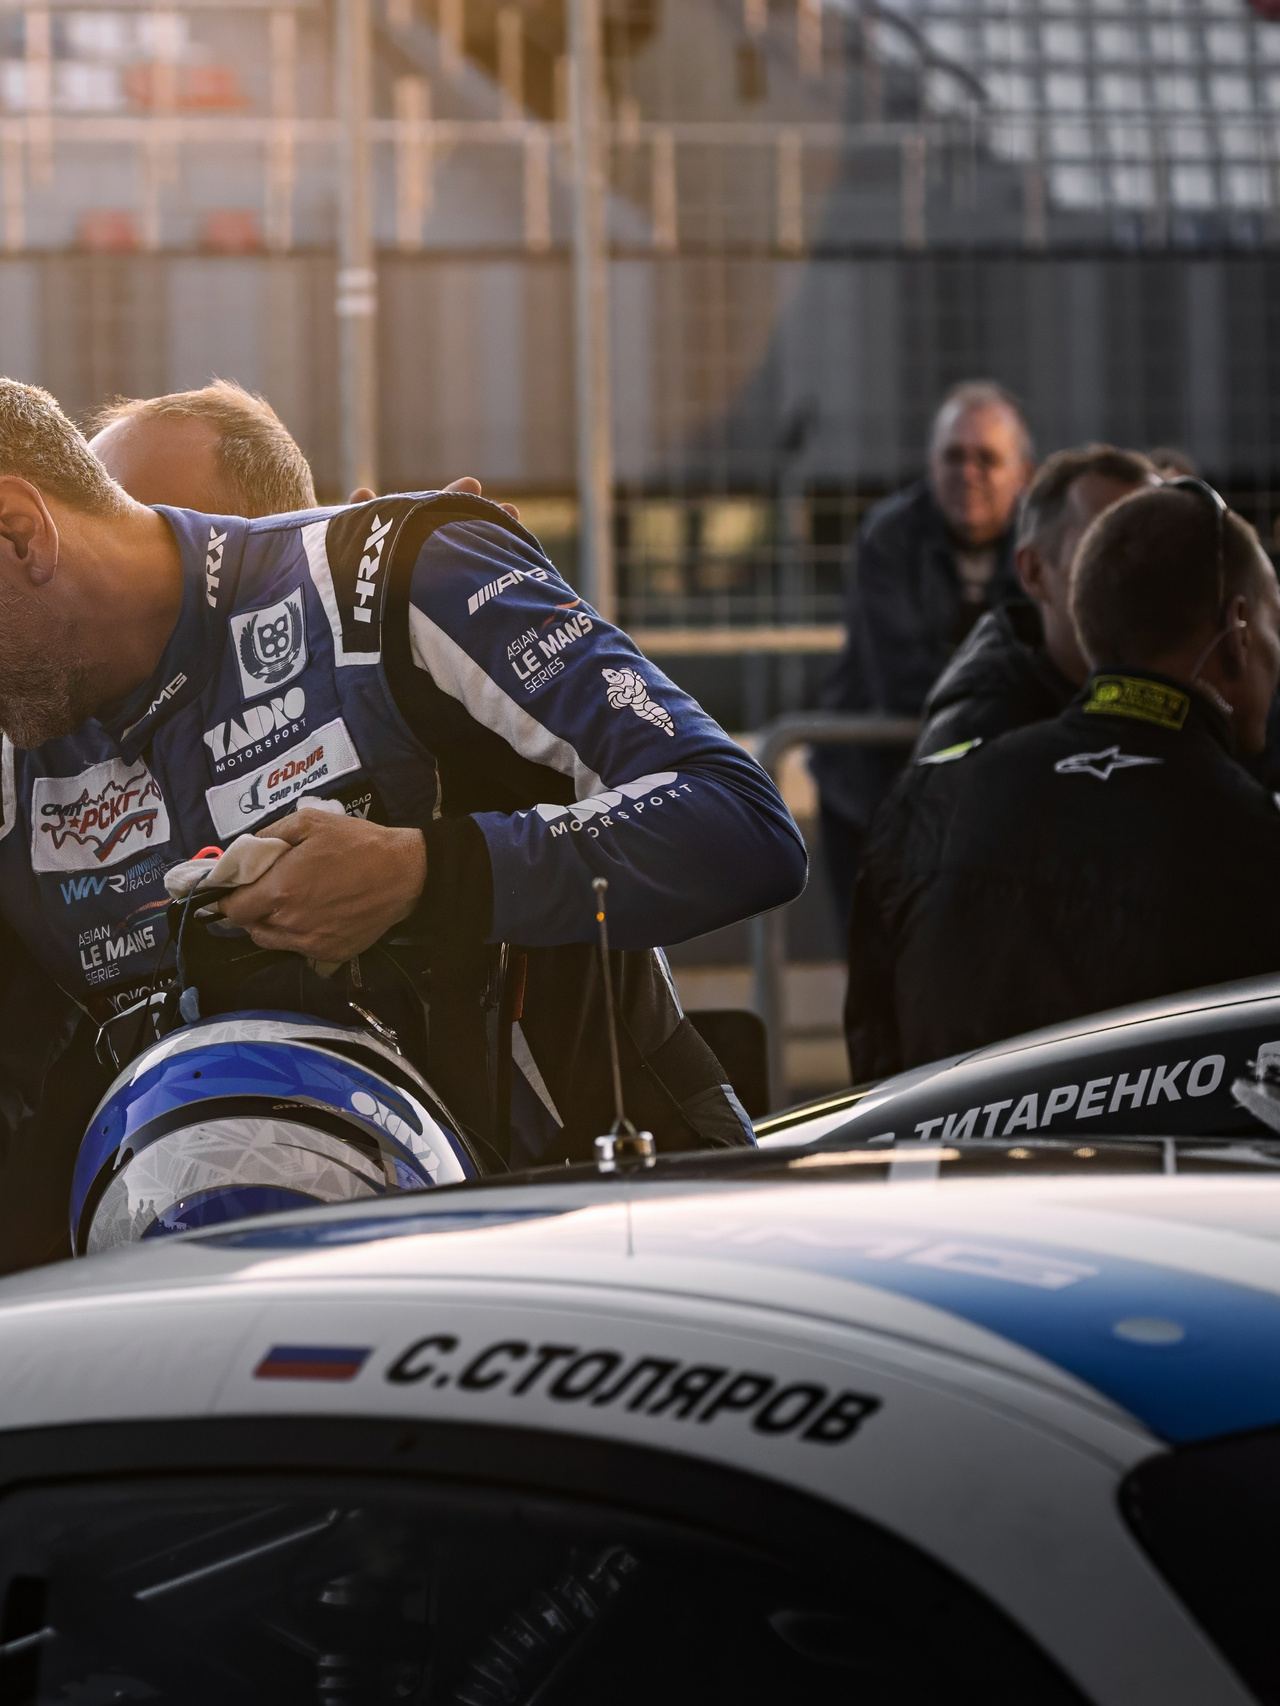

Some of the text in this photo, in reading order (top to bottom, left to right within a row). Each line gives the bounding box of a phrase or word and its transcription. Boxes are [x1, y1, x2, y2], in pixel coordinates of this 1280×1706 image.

[353, 514, 394, 624] HRX
[506, 627, 539, 661] ASIAN
[511, 612, 594, 681] LE MANS
[524, 657, 565, 694] SERIES
[202, 686, 306, 763] YADRO
[216, 718, 307, 773] MOTORSPORT
[268, 763, 329, 806] SMP RACING
[78, 924, 111, 947] ASIAN
[80, 925, 156, 971] LE MANS
[85, 962, 120, 986] SERIES
[914, 1054, 1226, 1141] ТИТАРЕНКО
[385, 1335, 884, 1446] С.СТОЛЯРОВ
